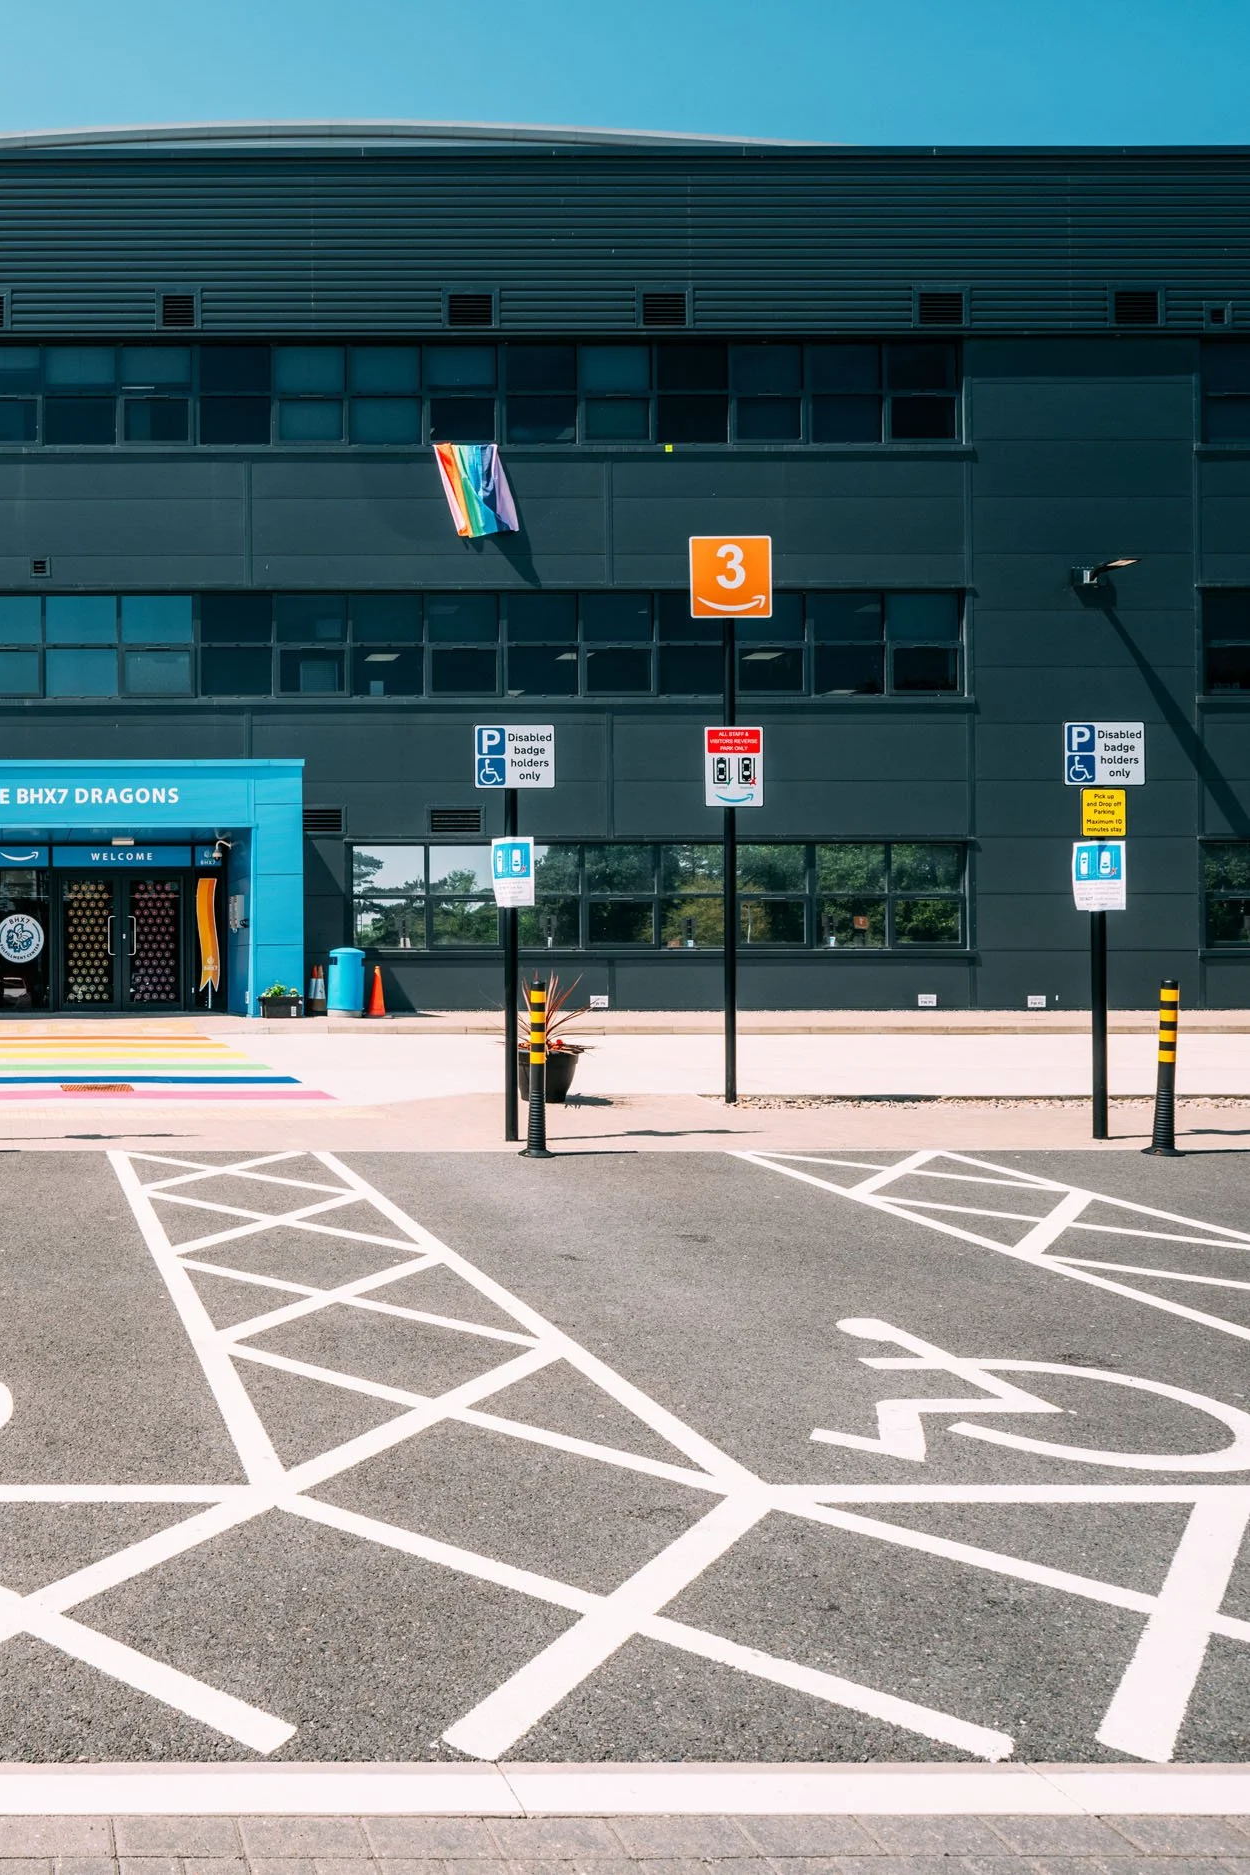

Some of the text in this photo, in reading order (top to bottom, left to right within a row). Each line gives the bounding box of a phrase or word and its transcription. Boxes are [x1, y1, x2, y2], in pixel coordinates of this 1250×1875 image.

[716, 544, 746, 590] 3
[508, 733, 552, 742] Disabled
[1072, 726, 1090, 751] P
[1098, 730, 1142, 739] Disabled
[482, 730, 500, 754] P
[514, 746, 545, 755] badge
[1104, 744, 1135, 753] badge
[511, 759, 549, 767] holders
[1101, 756, 1139, 764] holders
[519, 772, 541, 781] only
[1109, 769, 1131, 778] only
[17, 788, 69, 804] BHX7
[75, 788, 179, 804] DRAGONS
[91, 852, 153, 861] WELCOME
